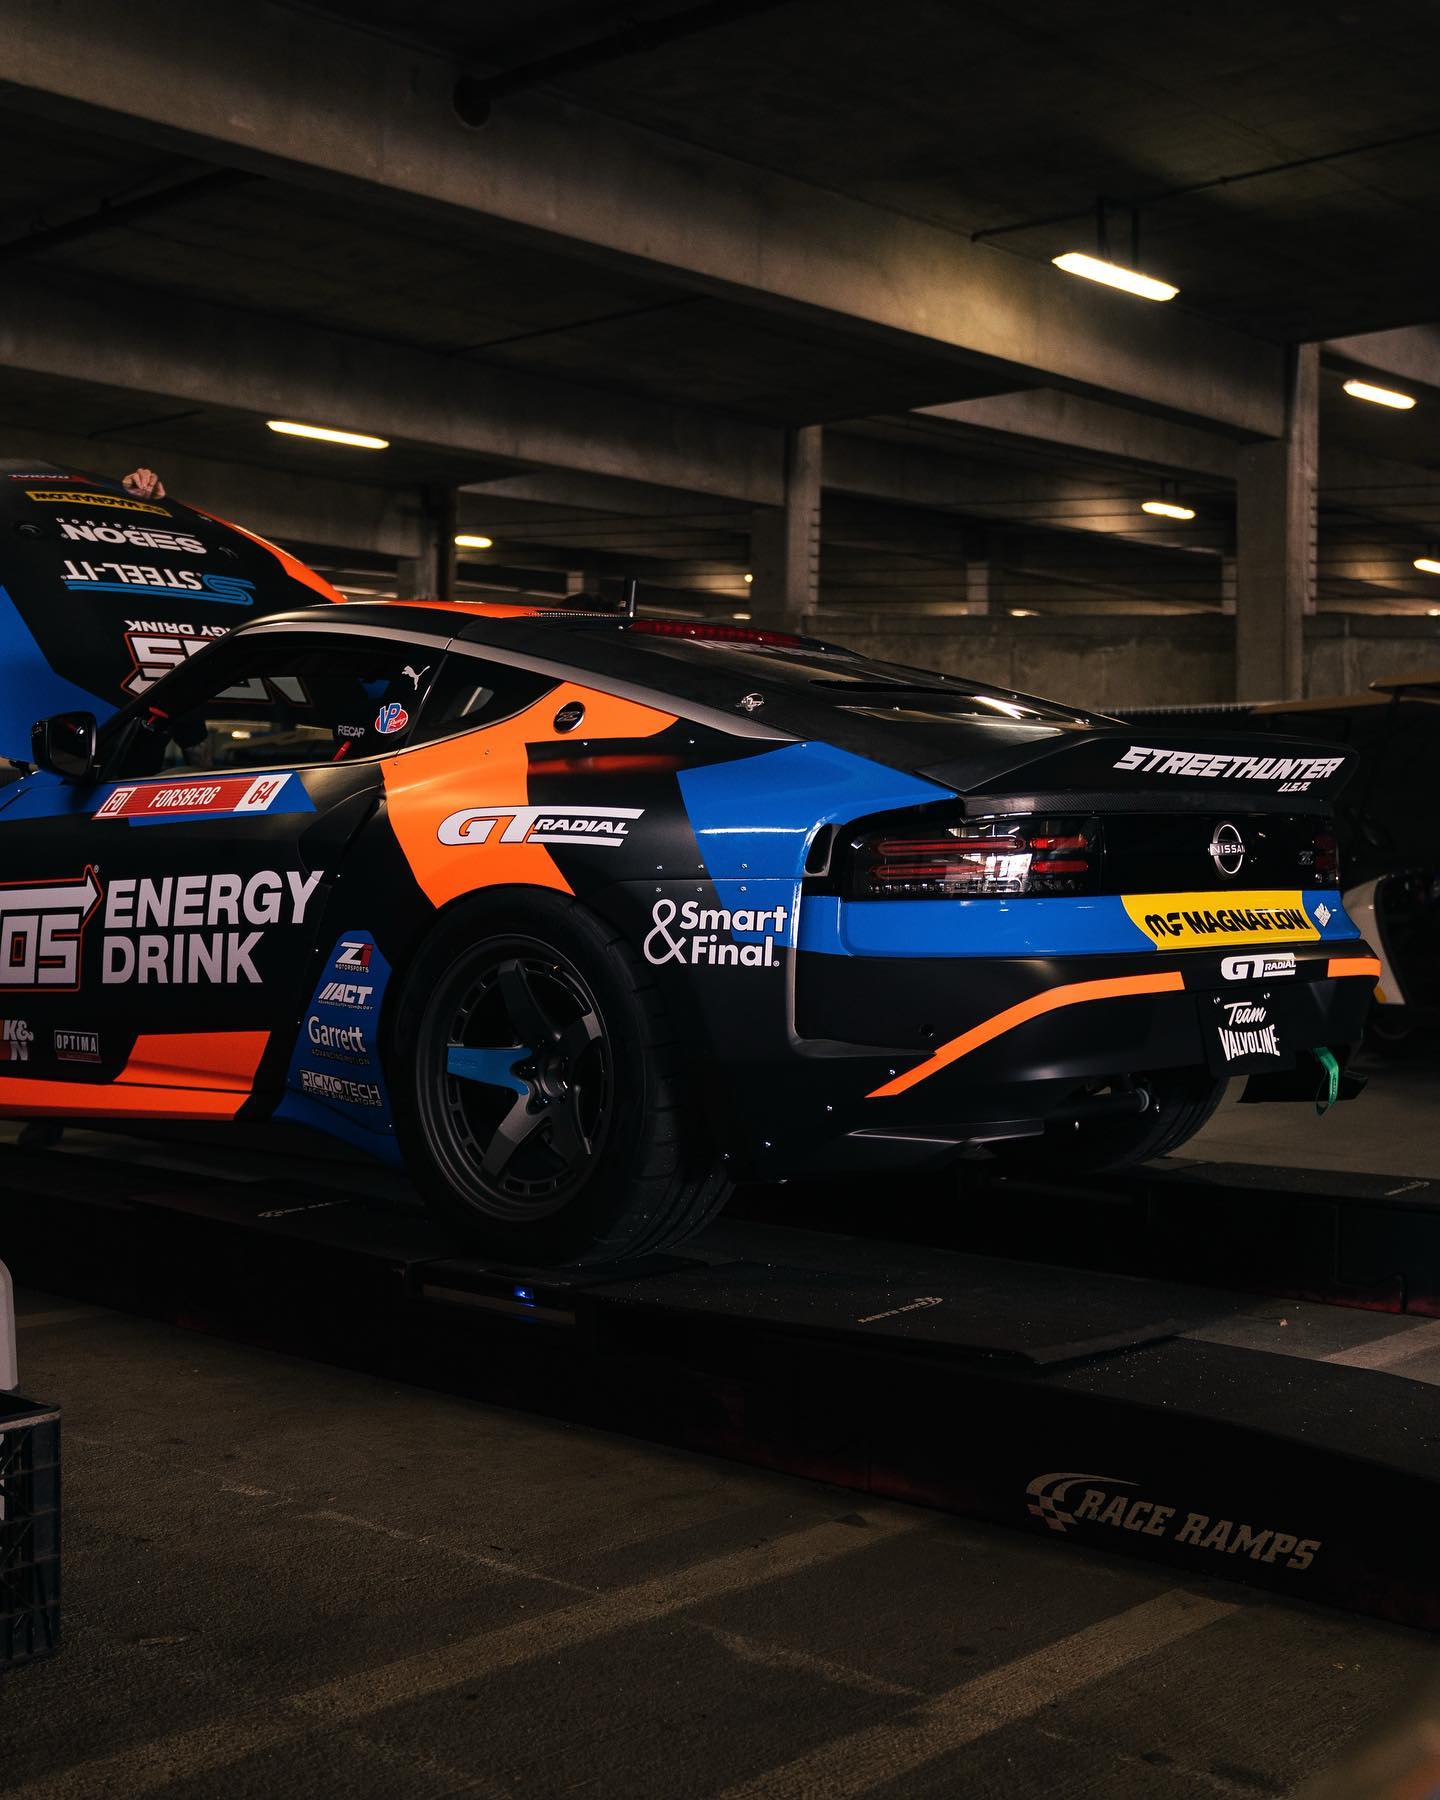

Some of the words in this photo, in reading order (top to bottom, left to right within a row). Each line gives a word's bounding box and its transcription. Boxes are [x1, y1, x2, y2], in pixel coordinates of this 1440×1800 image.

[61, 524, 207, 554] SEIBON
[63, 560, 202, 590] STEEL-IT
[124, 620, 194, 636] DRINK
[337, 724, 366, 738] RECAR
[379, 703, 403, 733] VP
[1113, 746, 1346, 780] STREETHUNTER
[104, 790, 129, 813] FD
[148, 786, 221, 808] FORSBERG
[248, 781, 279, 805] 64
[534, 819, 629, 835] RADIAL
[1211, 843, 1246, 855] NISSAN
[104, 870, 324, 929] ENERGY
[680, 901, 787, 931] Smart
[1182, 908, 1312, 934] MAGNAFLOW
[102, 931, 264, 984] DRINK
[335, 964, 369, 973] MOTORSPORTS
[1264, 958, 1296, 971] RADIAL
[1224, 1001, 1266, 1026] Team
[56, 1034, 97, 1053] OPTIMA
[308, 1015, 366, 1053] Garrett
[1218, 1025, 1281, 1061] VALVOLINE
[302, 1070, 380, 1099] RICMOTECH
[1073, 1489, 1176, 1537] RACE
[1174, 1513, 1323, 1570] RAMPS
